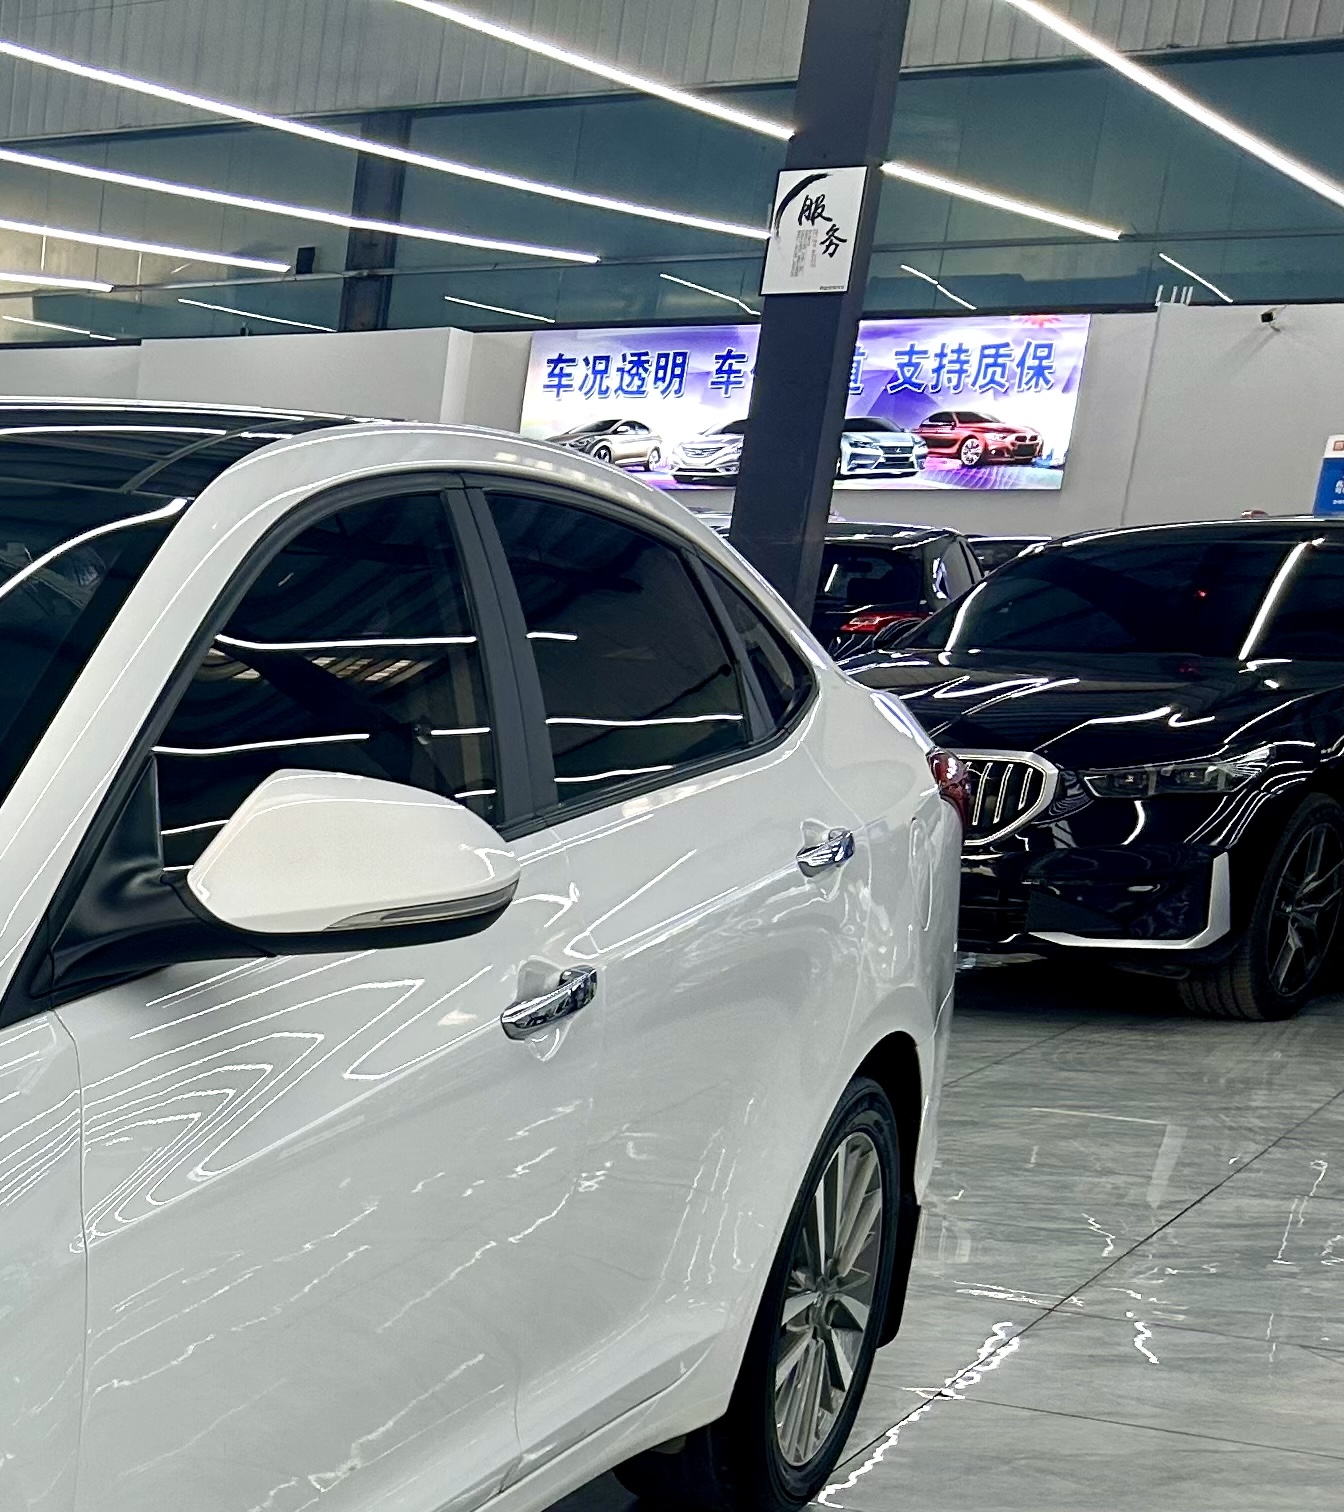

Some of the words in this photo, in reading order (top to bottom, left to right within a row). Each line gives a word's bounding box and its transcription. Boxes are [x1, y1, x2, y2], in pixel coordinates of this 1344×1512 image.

[797, 194, 848, 258] 服务
[543, 353, 689, 399] 车况透明
[711, 349, 755, 397] 车
[888, 340, 1054, 393] 支持质保
